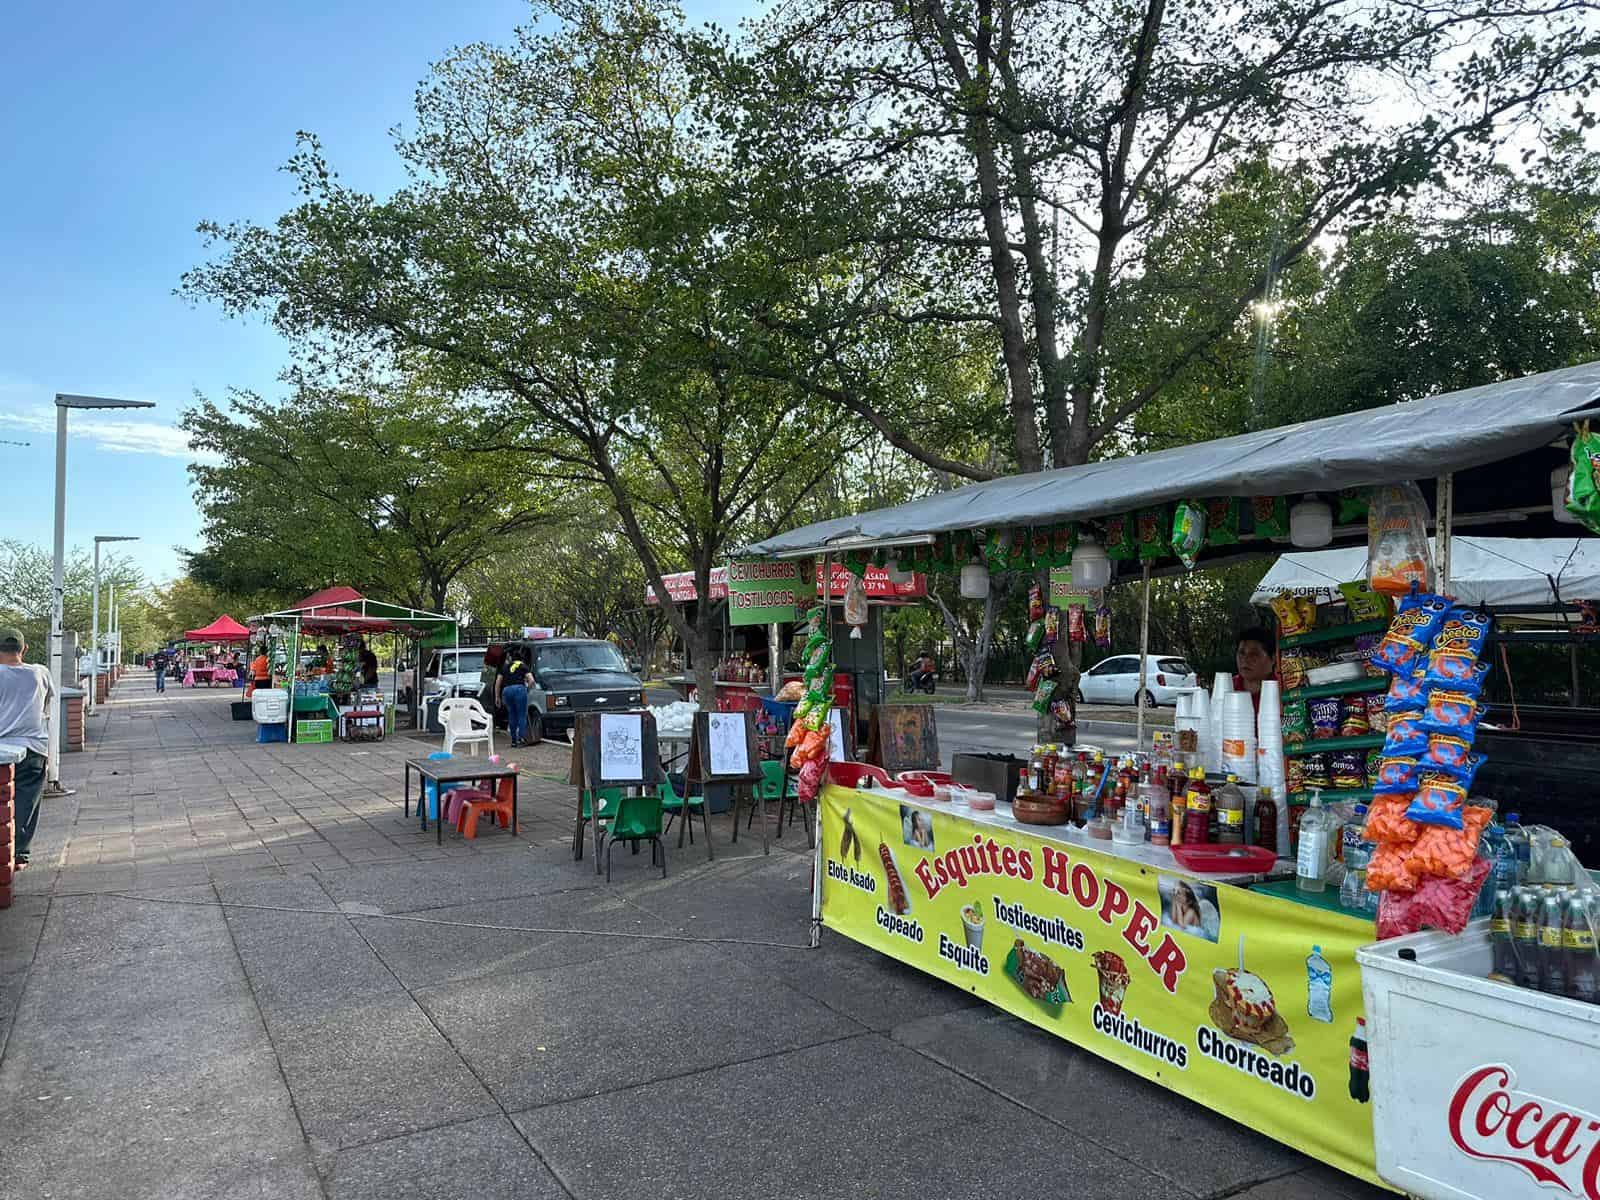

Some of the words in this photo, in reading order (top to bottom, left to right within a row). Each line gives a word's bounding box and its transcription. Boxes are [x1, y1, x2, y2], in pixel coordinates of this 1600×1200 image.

[730, 561, 796, 580] CEVICHURROS
[729, 589, 795, 608] TOSTILOCOS
[1388, 613, 1432, 632] Cheetos
[1434, 625, 1480, 649] Cheetos
[828, 859, 849, 883] Elote
[850, 869, 876, 893] Asado
[876, 906, 924, 943] Capeado
[915, 834, 1034, 900] Esquites
[1041, 845, 1187, 994] HOPER
[993, 897, 1084, 950] Tostiesquites
[939, 934, 989, 975] Esquite
[1093, 1004, 1187, 1068] Cevichurros
[1197, 1027, 1315, 1098] Chorreado
